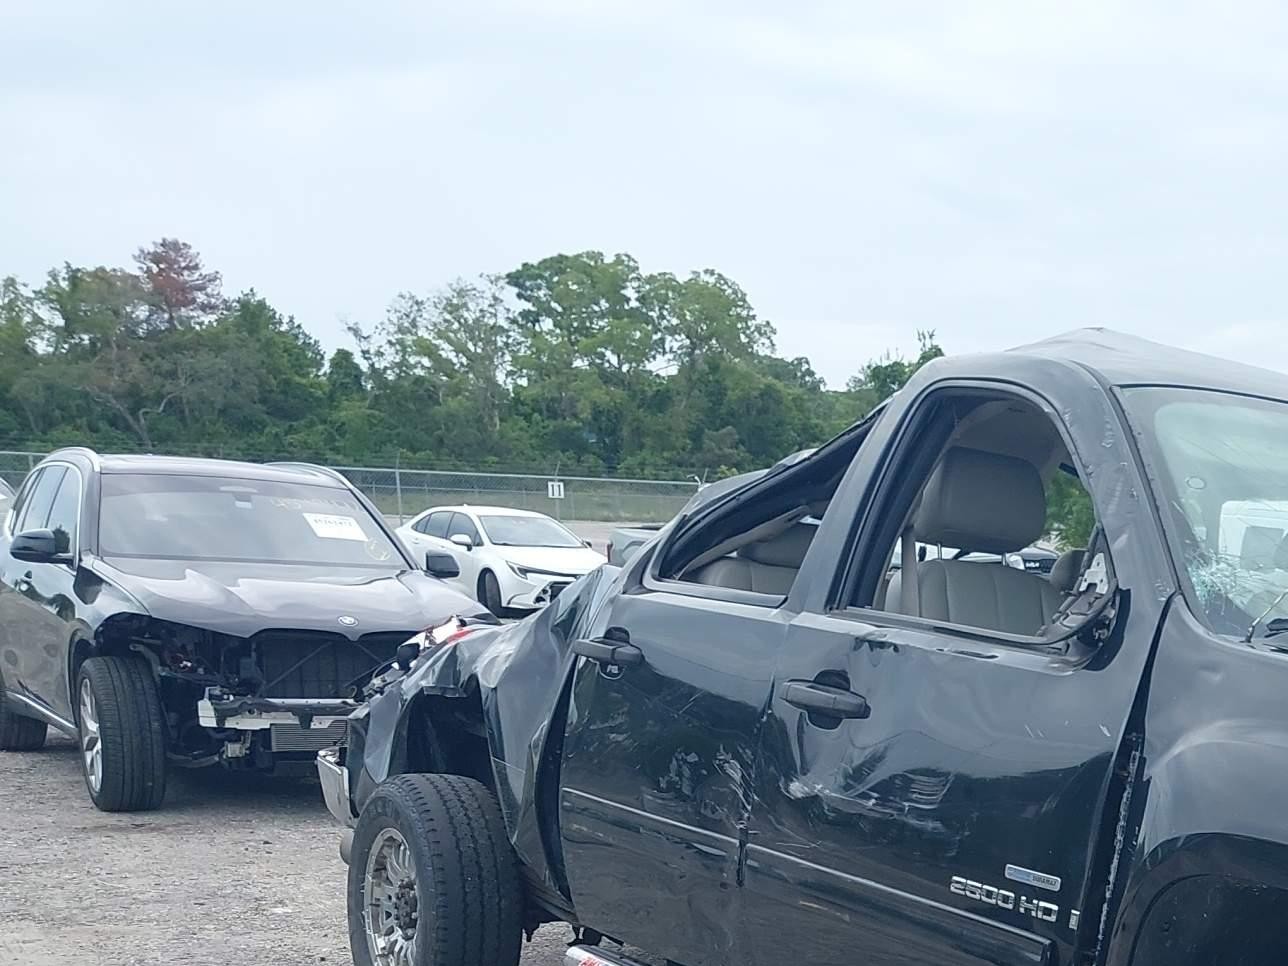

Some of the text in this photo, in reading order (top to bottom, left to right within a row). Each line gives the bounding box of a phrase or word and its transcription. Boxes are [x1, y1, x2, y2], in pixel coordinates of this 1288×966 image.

[550, 483, 562, 497] 11
[949, 875, 1016, 910] 2500
[1018, 895, 1059, 923] HD
